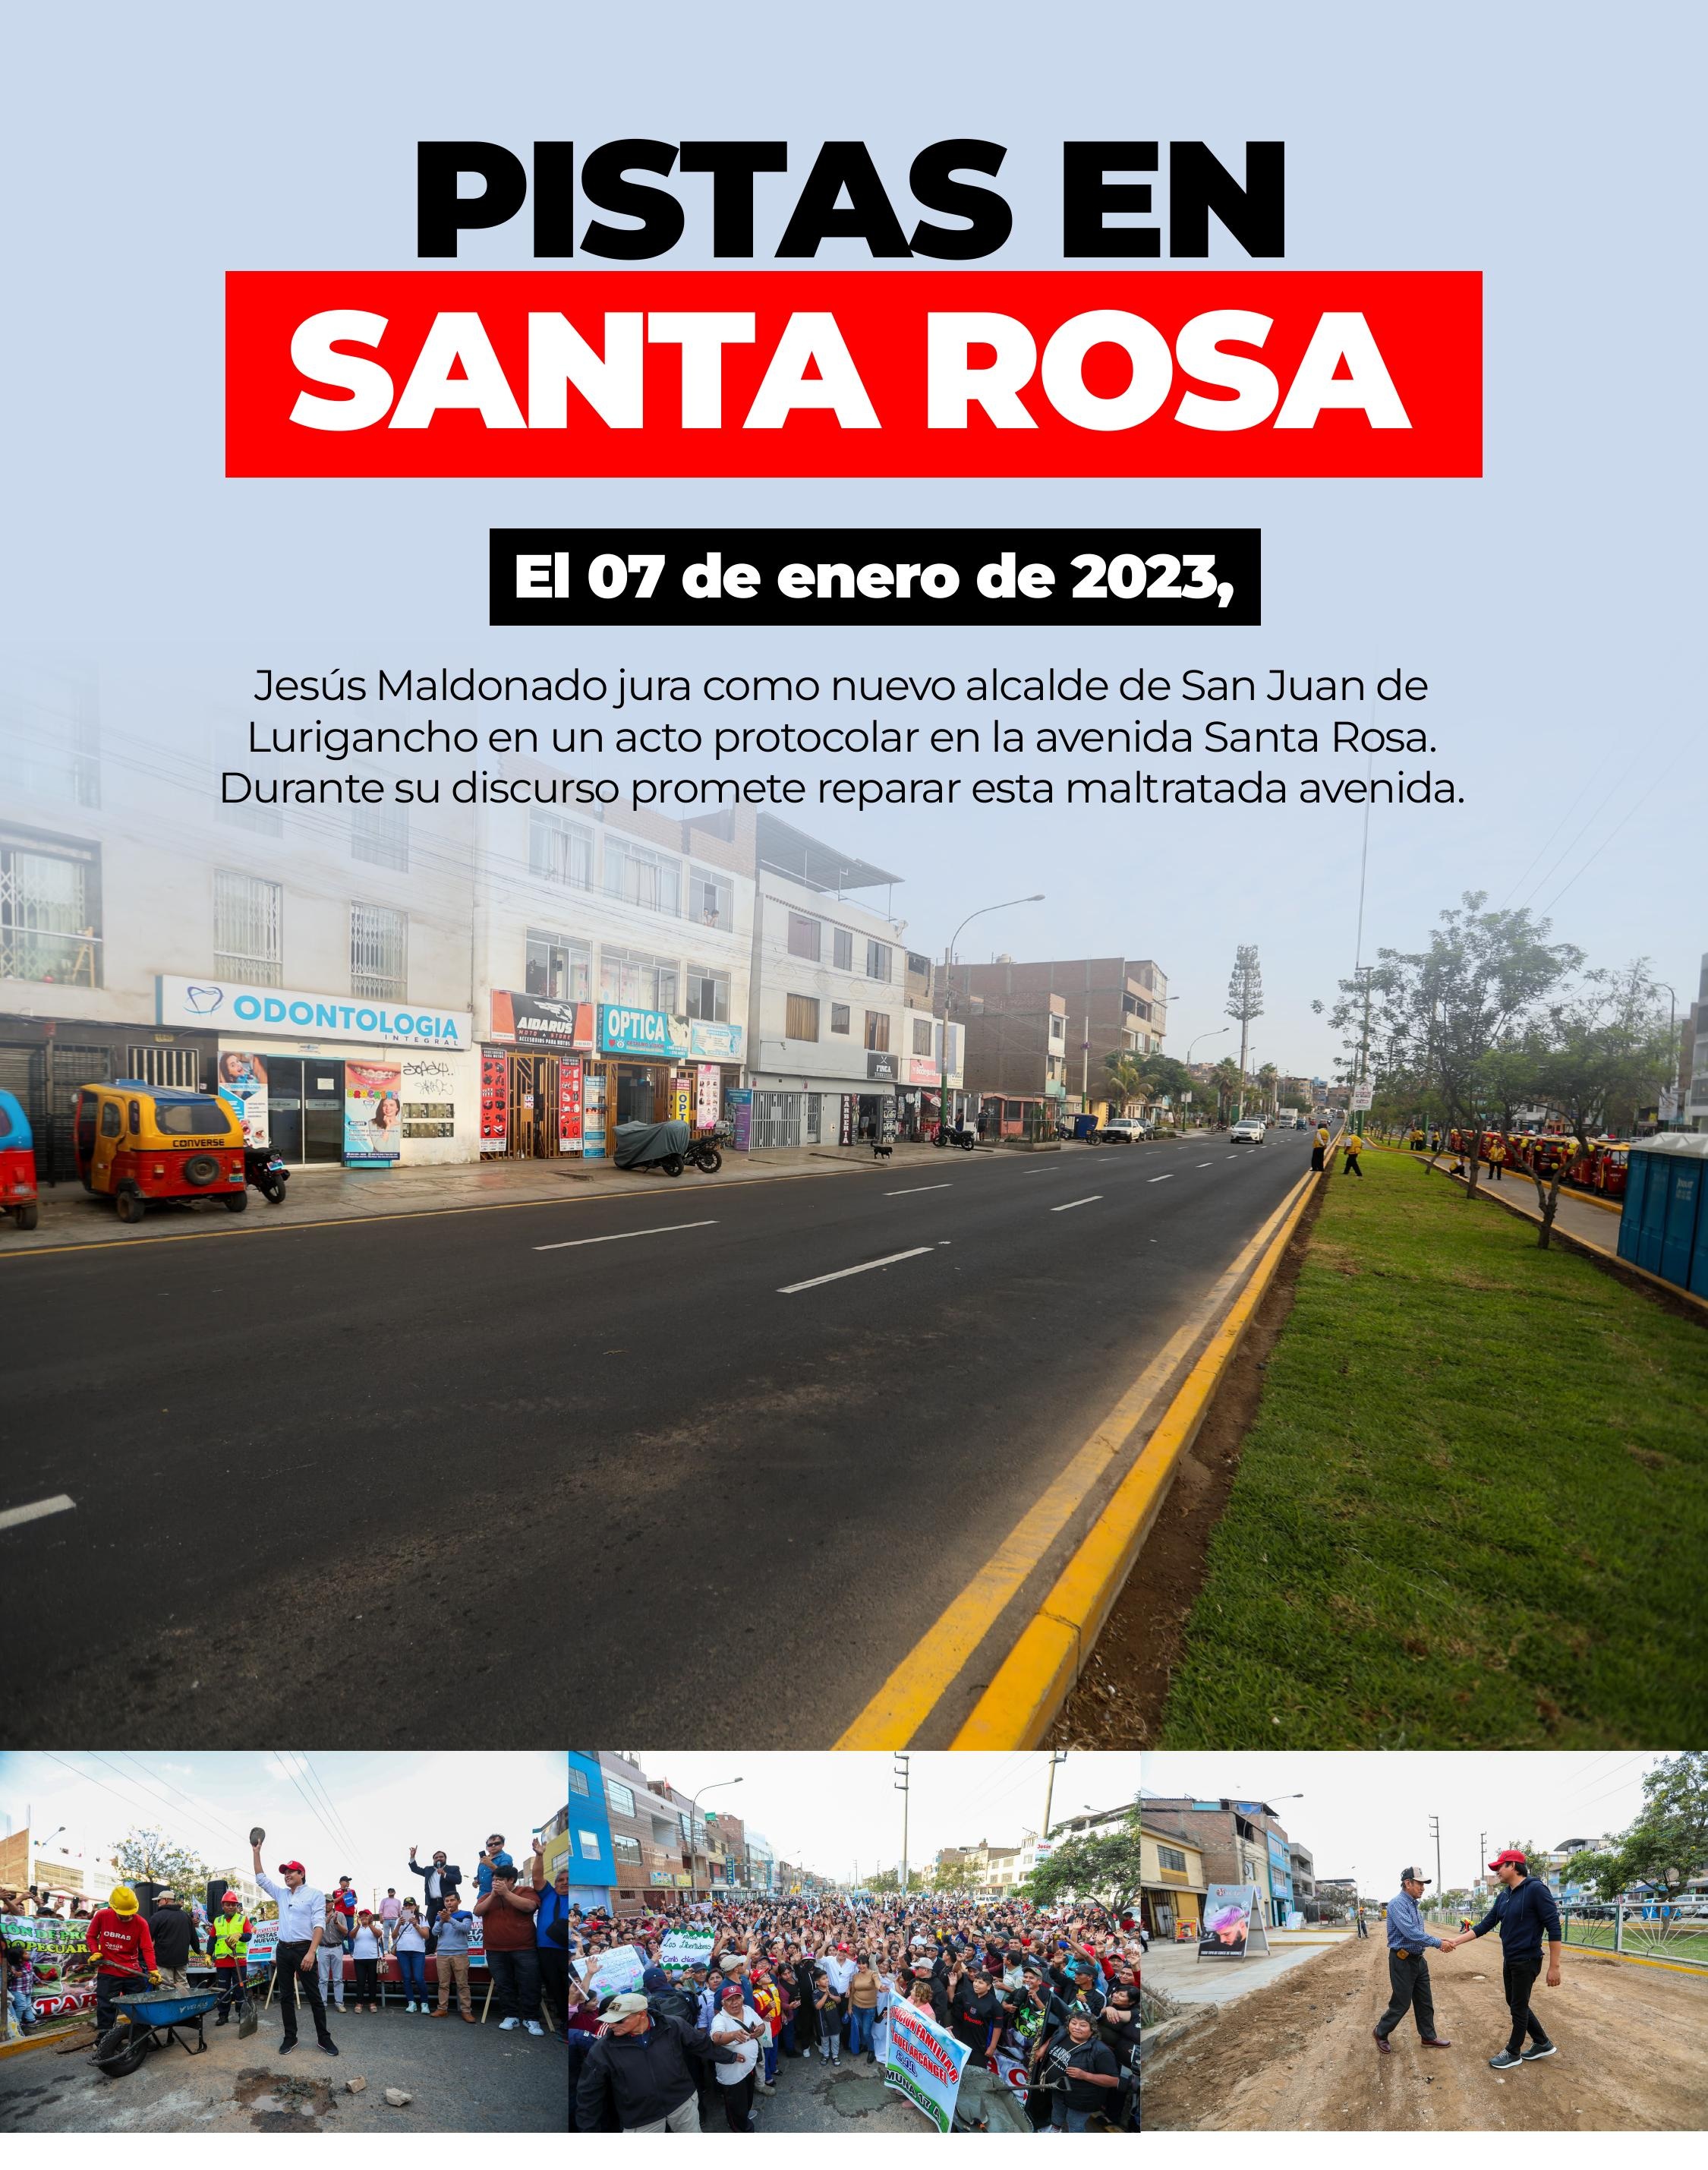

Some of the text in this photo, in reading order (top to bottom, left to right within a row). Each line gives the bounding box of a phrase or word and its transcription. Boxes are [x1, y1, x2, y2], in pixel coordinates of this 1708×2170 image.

[234, 995, 458, 1039] ODONTOLOGIA
[517, 1017, 572, 1033] AIDARUS
[608, 1009, 665, 1041] OPTICA
[385, 1034, 459, 1046] INTEGRAL
[876, 1064, 891, 1073] FINCA
[172, 1139, 225, 1147] CONVERSE
[36, 1929, 57, 1939] DE
[104, 1931, 131, 1941] OBRAS
[915, 2023, 959, 2085] FAMILIAR
[909, 2044, 948, 2087] ARCÁNGEL
[918, 2092, 931, 2109] 17
[933, 2106, 941, 2124] A
